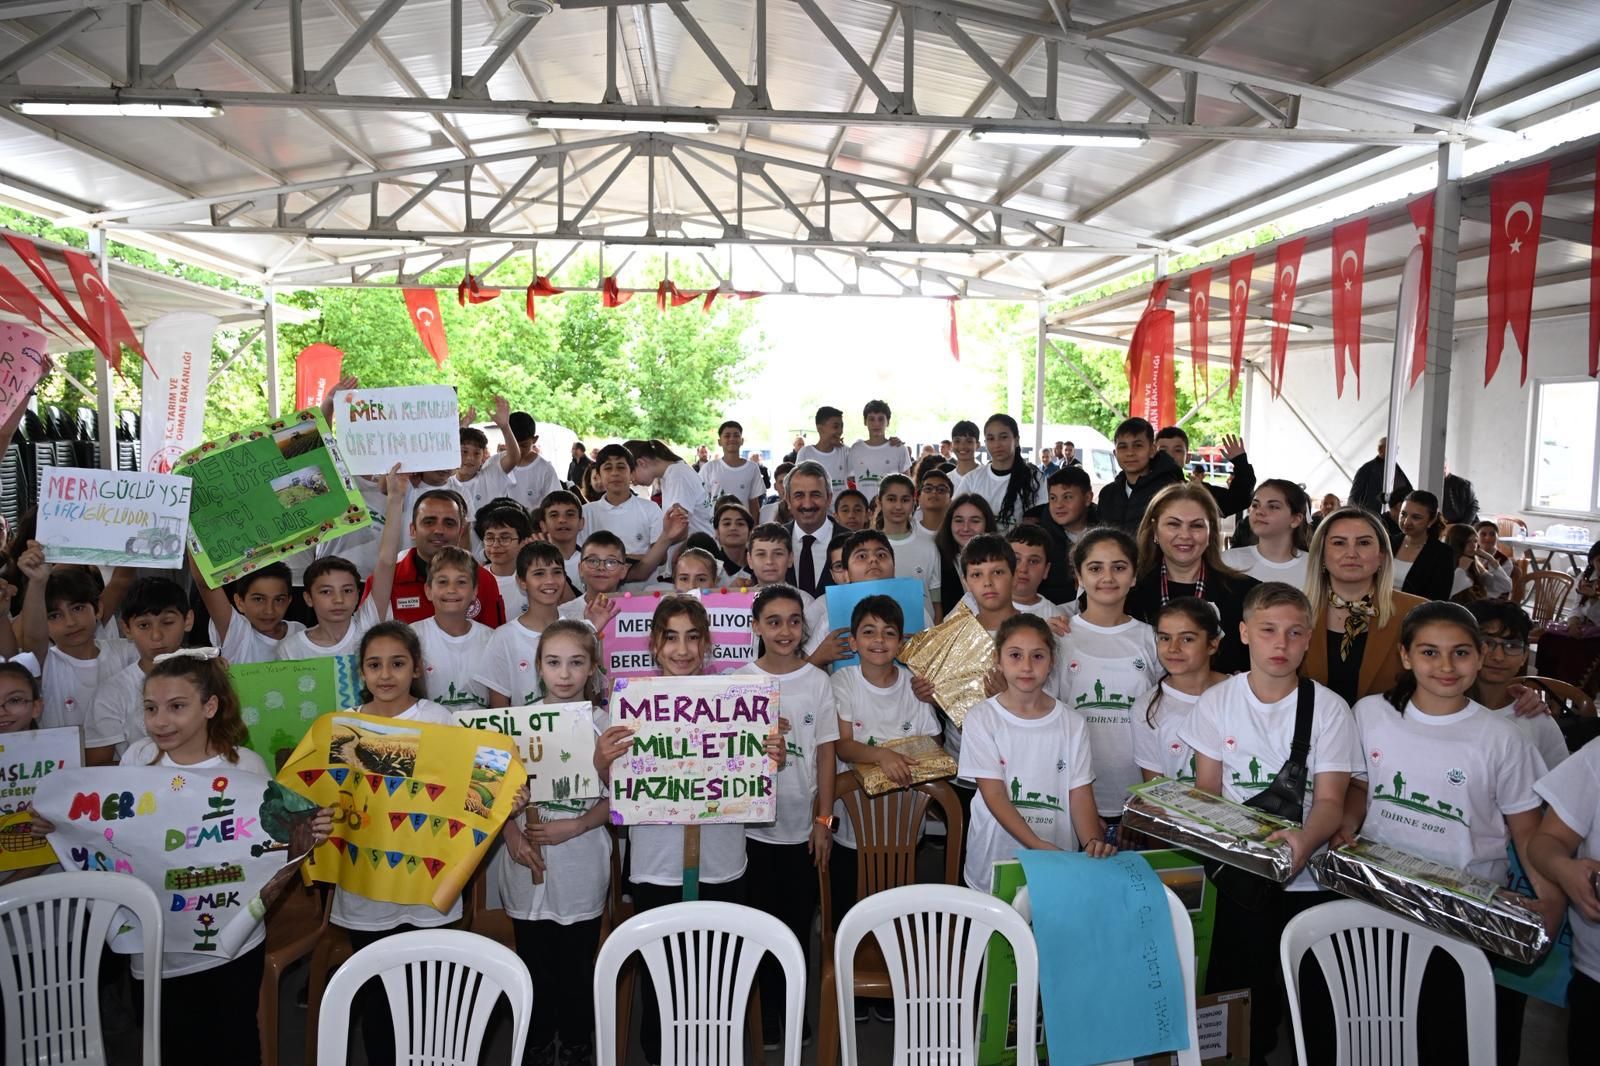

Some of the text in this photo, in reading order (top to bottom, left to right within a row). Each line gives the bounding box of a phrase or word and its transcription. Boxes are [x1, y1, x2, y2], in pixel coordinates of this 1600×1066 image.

[166, 377, 179, 440] T.C. TARIM VE
[176, 351, 192, 440] ORMAN BAKANLIĞI
[1143, 383, 1151, 421] ARIM VE
[1150, 409, 1159, 432] MAN
[184, 446, 256, 484] MERA
[48, 475, 98, 501] MERA
[618, 613, 753, 633] MER ILIYOR
[712, 644, 753, 659] ĞALIY
[529, 711, 560, 732] OT
[619, 694, 771, 725] MERALAR
[1120, 716, 1131, 724] 202
[632, 730, 769, 759] MİLLETİN
[303, 768, 438, 796] BEREKET
[68, 791, 158, 822] MERA
[164, 817, 257, 851] DEMEK
[1034, 816, 1054, 825] 2026
[1421, 822, 1446, 834] 2026
[170, 891, 240, 912] DEMEK
